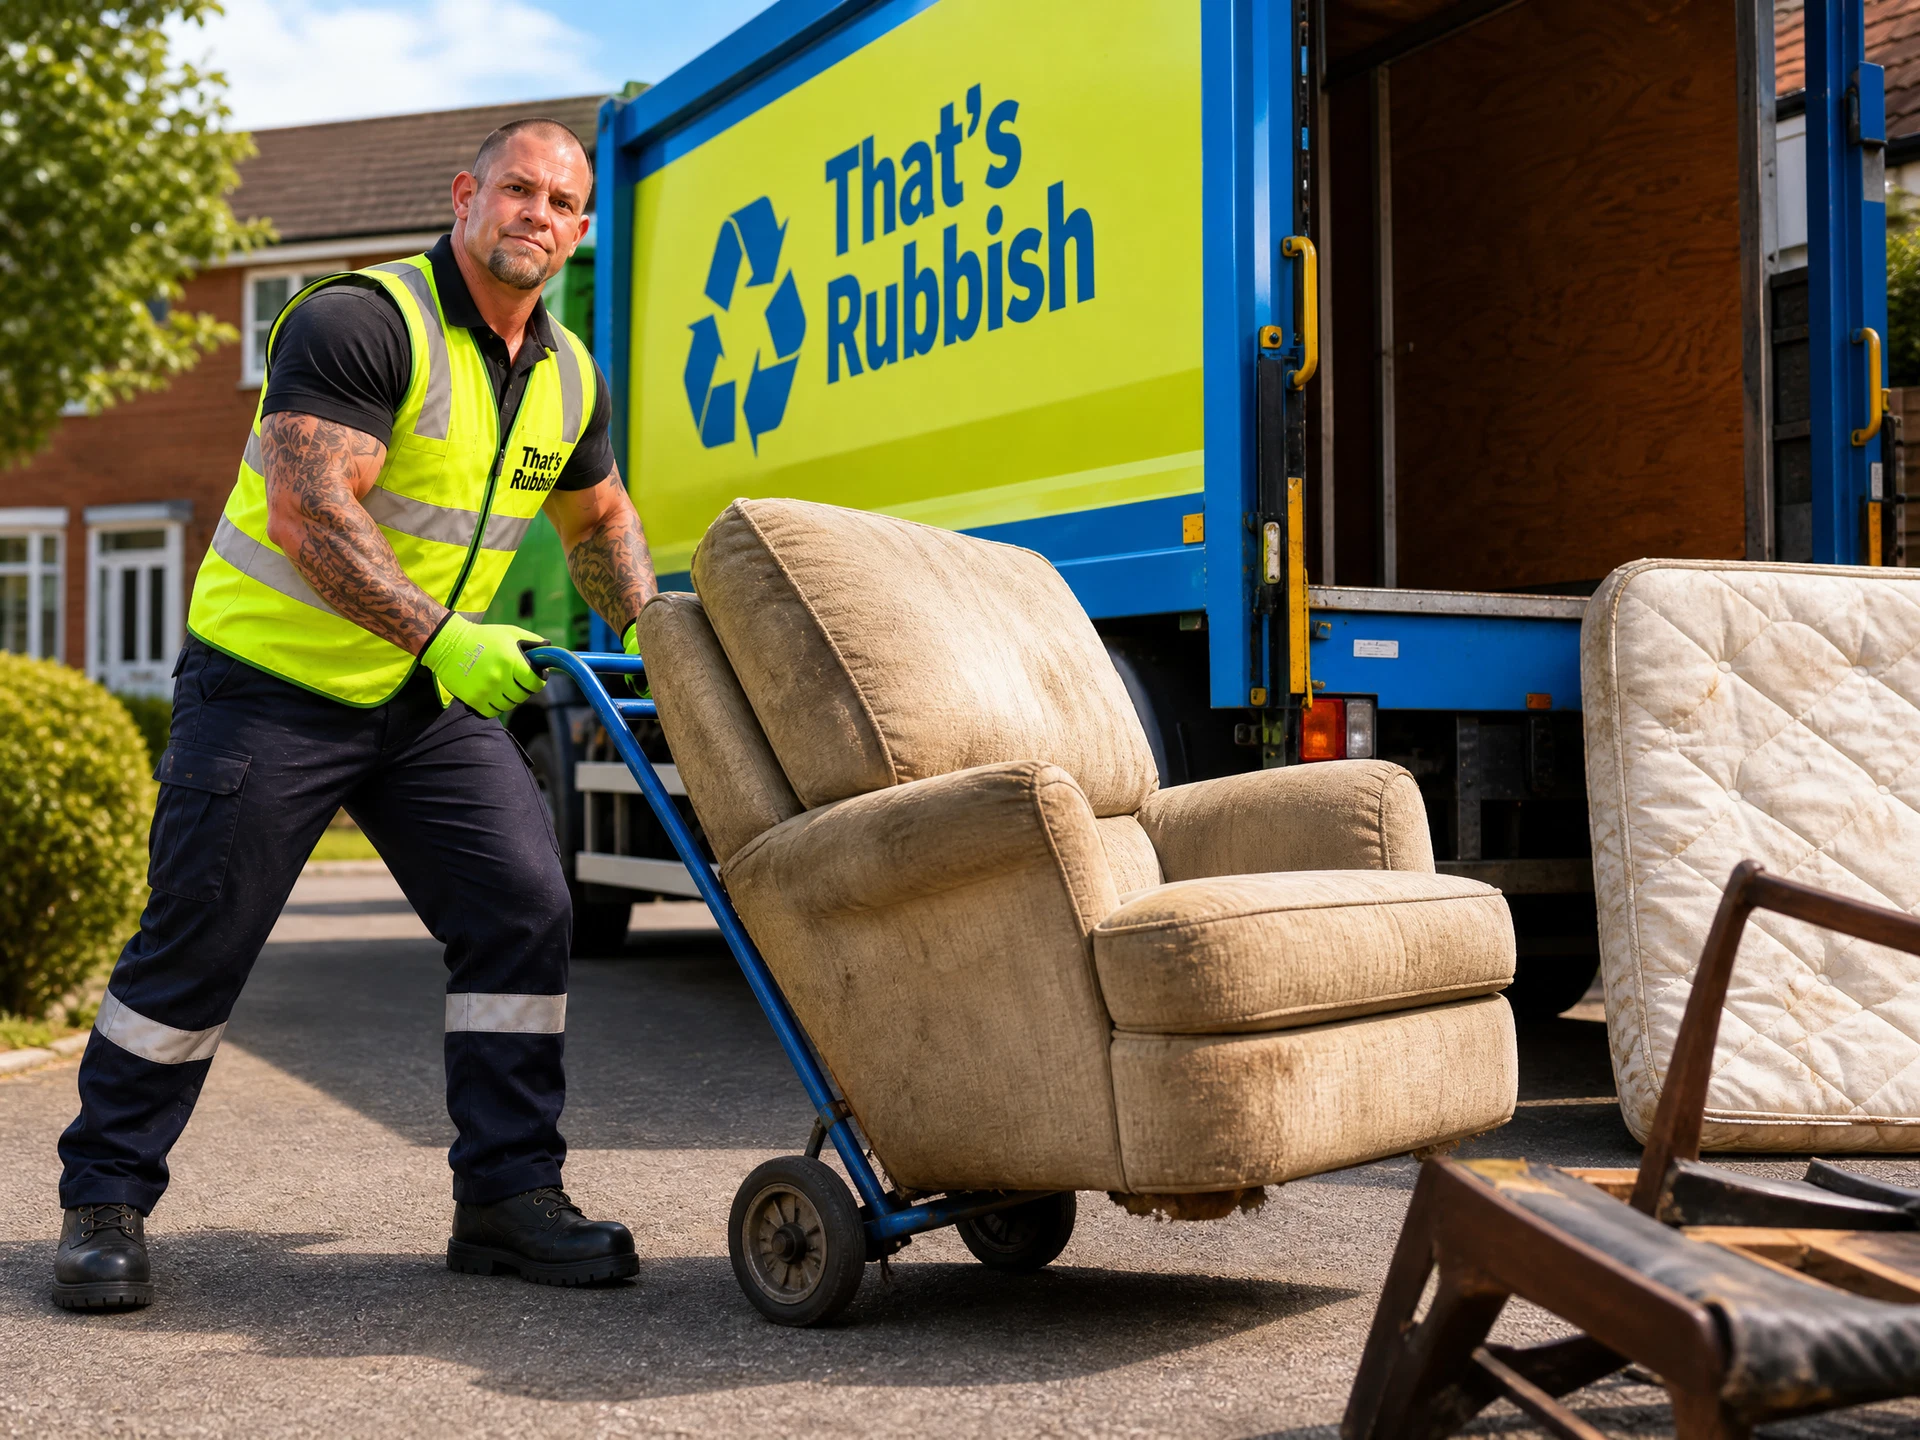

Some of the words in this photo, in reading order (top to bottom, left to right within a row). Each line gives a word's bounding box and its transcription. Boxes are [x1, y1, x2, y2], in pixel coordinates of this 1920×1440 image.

[825, 83, 1021, 257] That's
[827, 180, 1095, 385] Rubbish
[522, 446, 562, 471] That's
